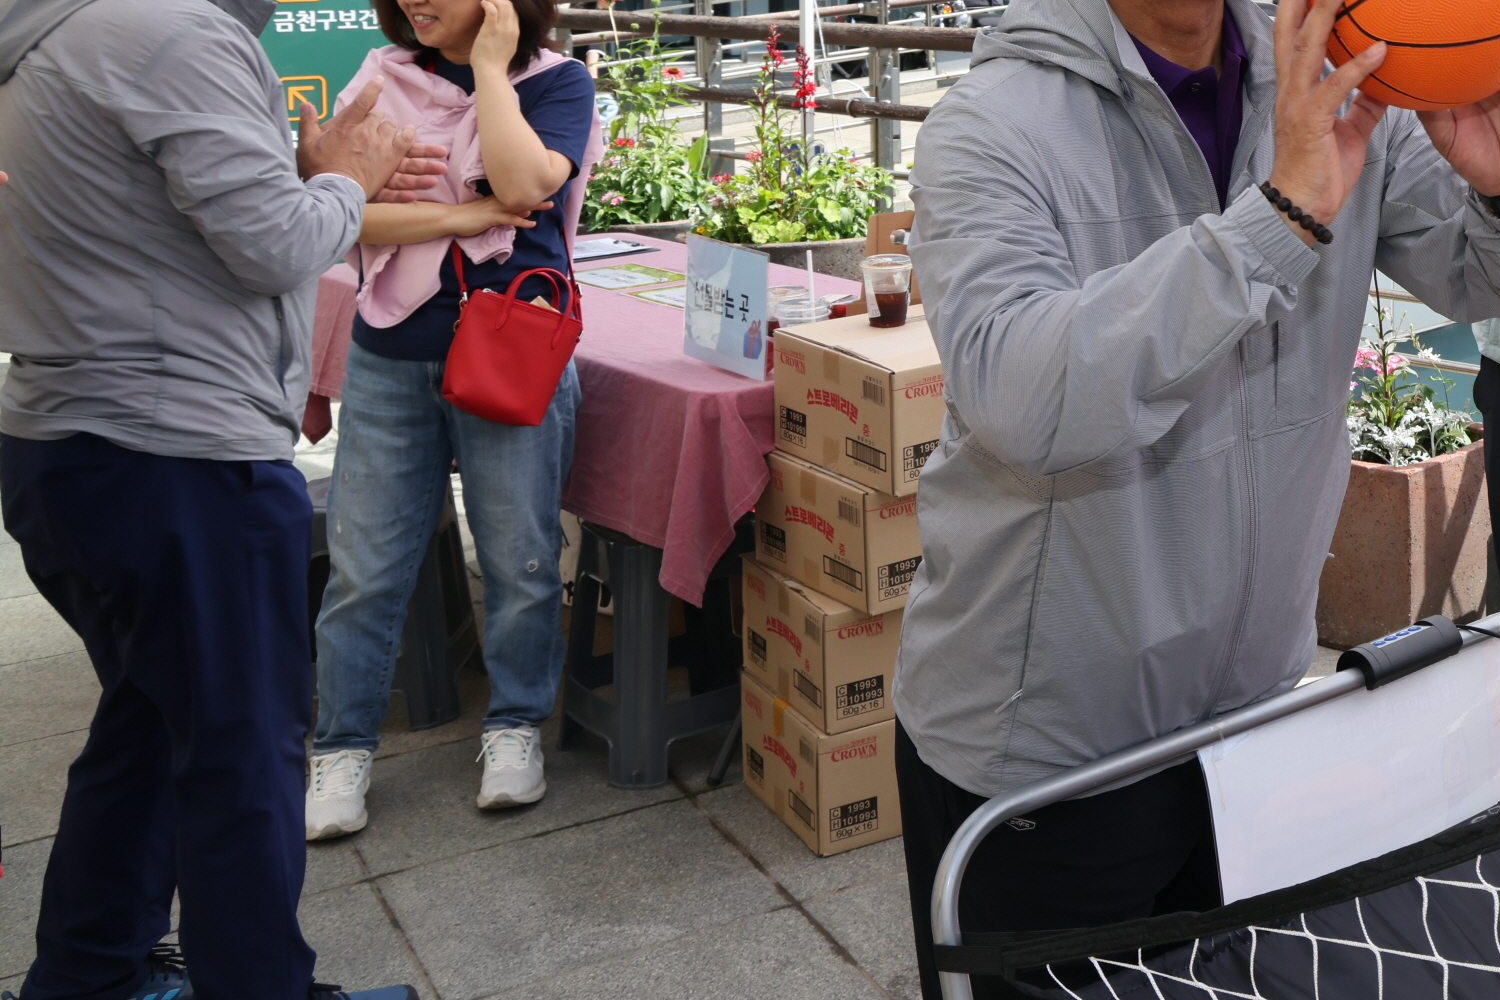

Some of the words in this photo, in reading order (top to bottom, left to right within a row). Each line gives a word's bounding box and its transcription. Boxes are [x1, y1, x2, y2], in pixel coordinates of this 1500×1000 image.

[273, 10, 381, 33] 금천구보건
[780, 351, 806, 373] CROWN
[806, 388, 859, 425] 스트로베리콘
[790, 411, 803, 423] 1993
[787, 421, 806, 436] 101993
[905, 448, 913, 459] C
[906, 460, 913, 471] H
[879, 502, 917, 519] CROW
[785, 505, 835, 544] 스트로베리콘
[880, 567, 888, 577] C
[894, 559, 916, 572] 1993
[881, 579, 888, 588] H
[889, 571, 916, 586] 10199
[838, 621, 883, 639] CROWN
[838, 686, 846, 696] C
[853, 678, 877, 692] 1993
[838, 698, 847, 707] H
[848, 688, 883, 705] 101993
[842, 706, 860, 717] 60g
[868, 700, 879, 709] 16
[831, 743, 877, 762] CROWN
[832, 808, 840, 819] C
[847, 800, 871, 814] 1993
[832, 820, 840, 830] H
[842, 810, 877, 827] 101993
[836, 828, 853, 839] 60g
[862, 821, 873, 830] 16
